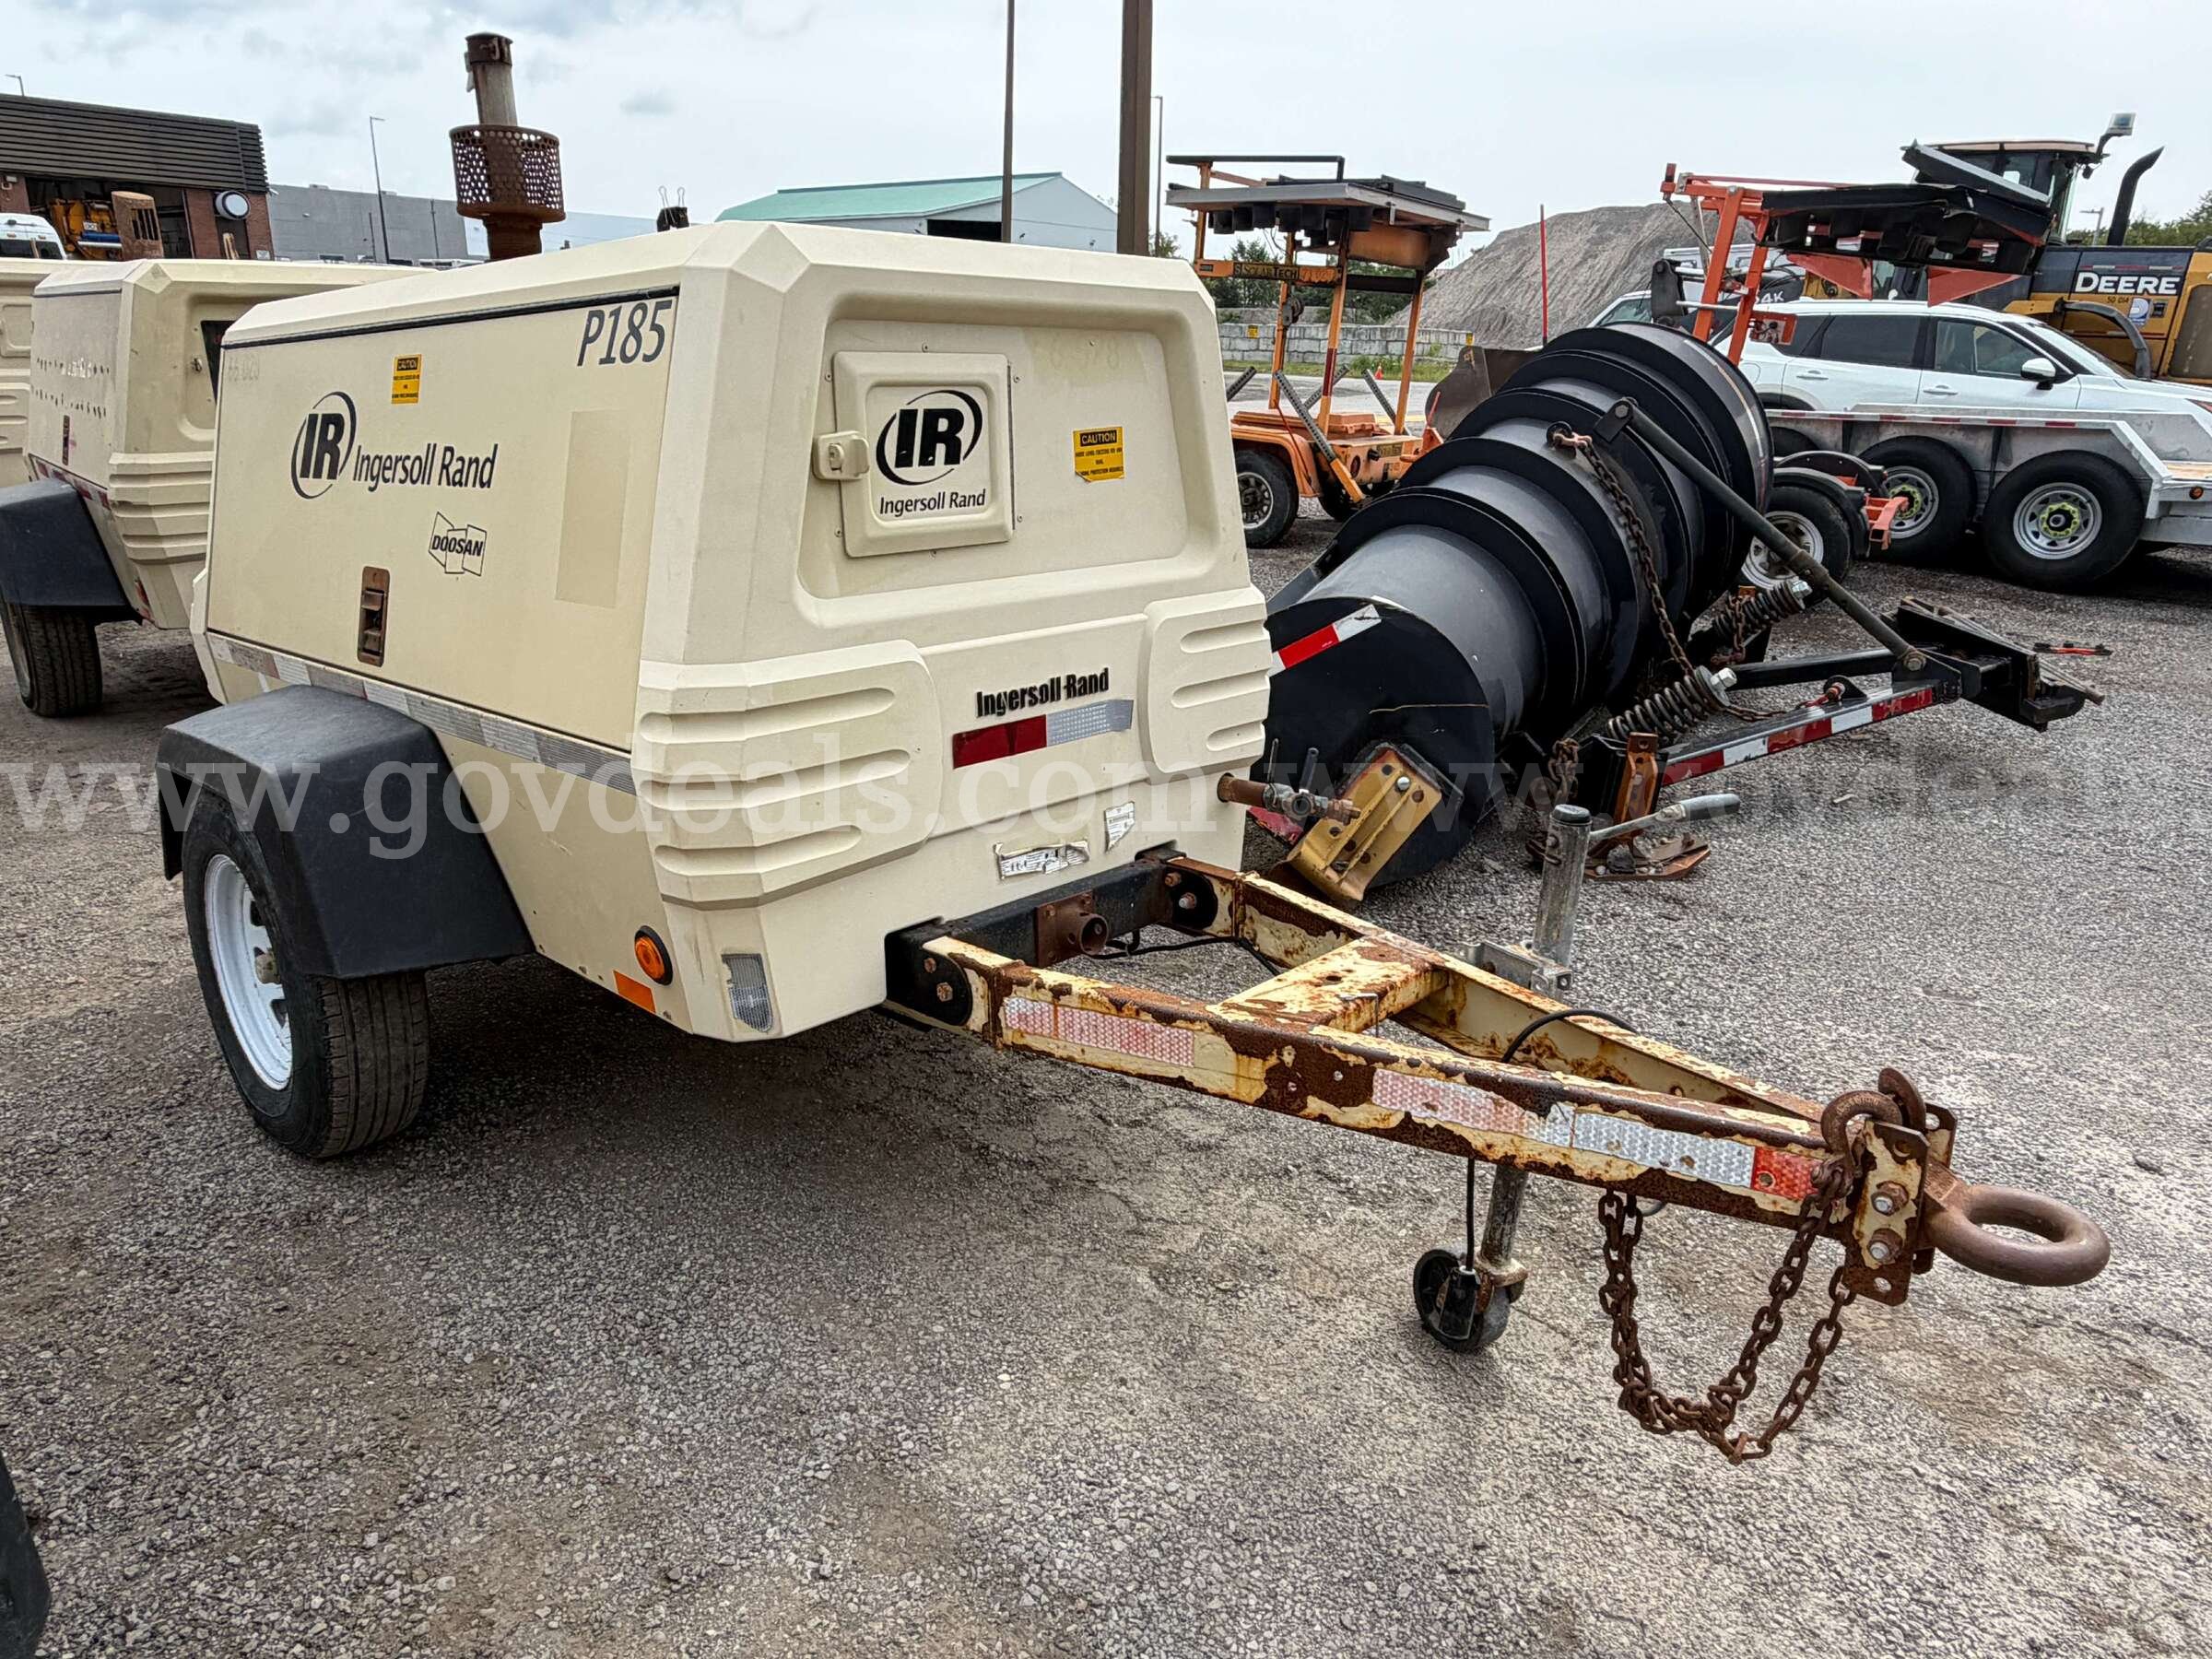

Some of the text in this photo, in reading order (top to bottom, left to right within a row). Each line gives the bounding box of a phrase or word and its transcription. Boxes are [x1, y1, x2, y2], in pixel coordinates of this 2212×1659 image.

[1757, 291, 1784, 303] 4K
[2075, 271, 2181, 295] DEERE
[577, 300, 673, 367] P185
[300, 413, 345, 480] IR
[895, 408, 965, 468] IR
[1081, 431, 1116, 444] CAUTION
[352, 442, 499, 492] Ingersoll Rand
[879, 488, 986, 517] Ingersoll Rand
[431, 535, 484, 557] DOOSAN
